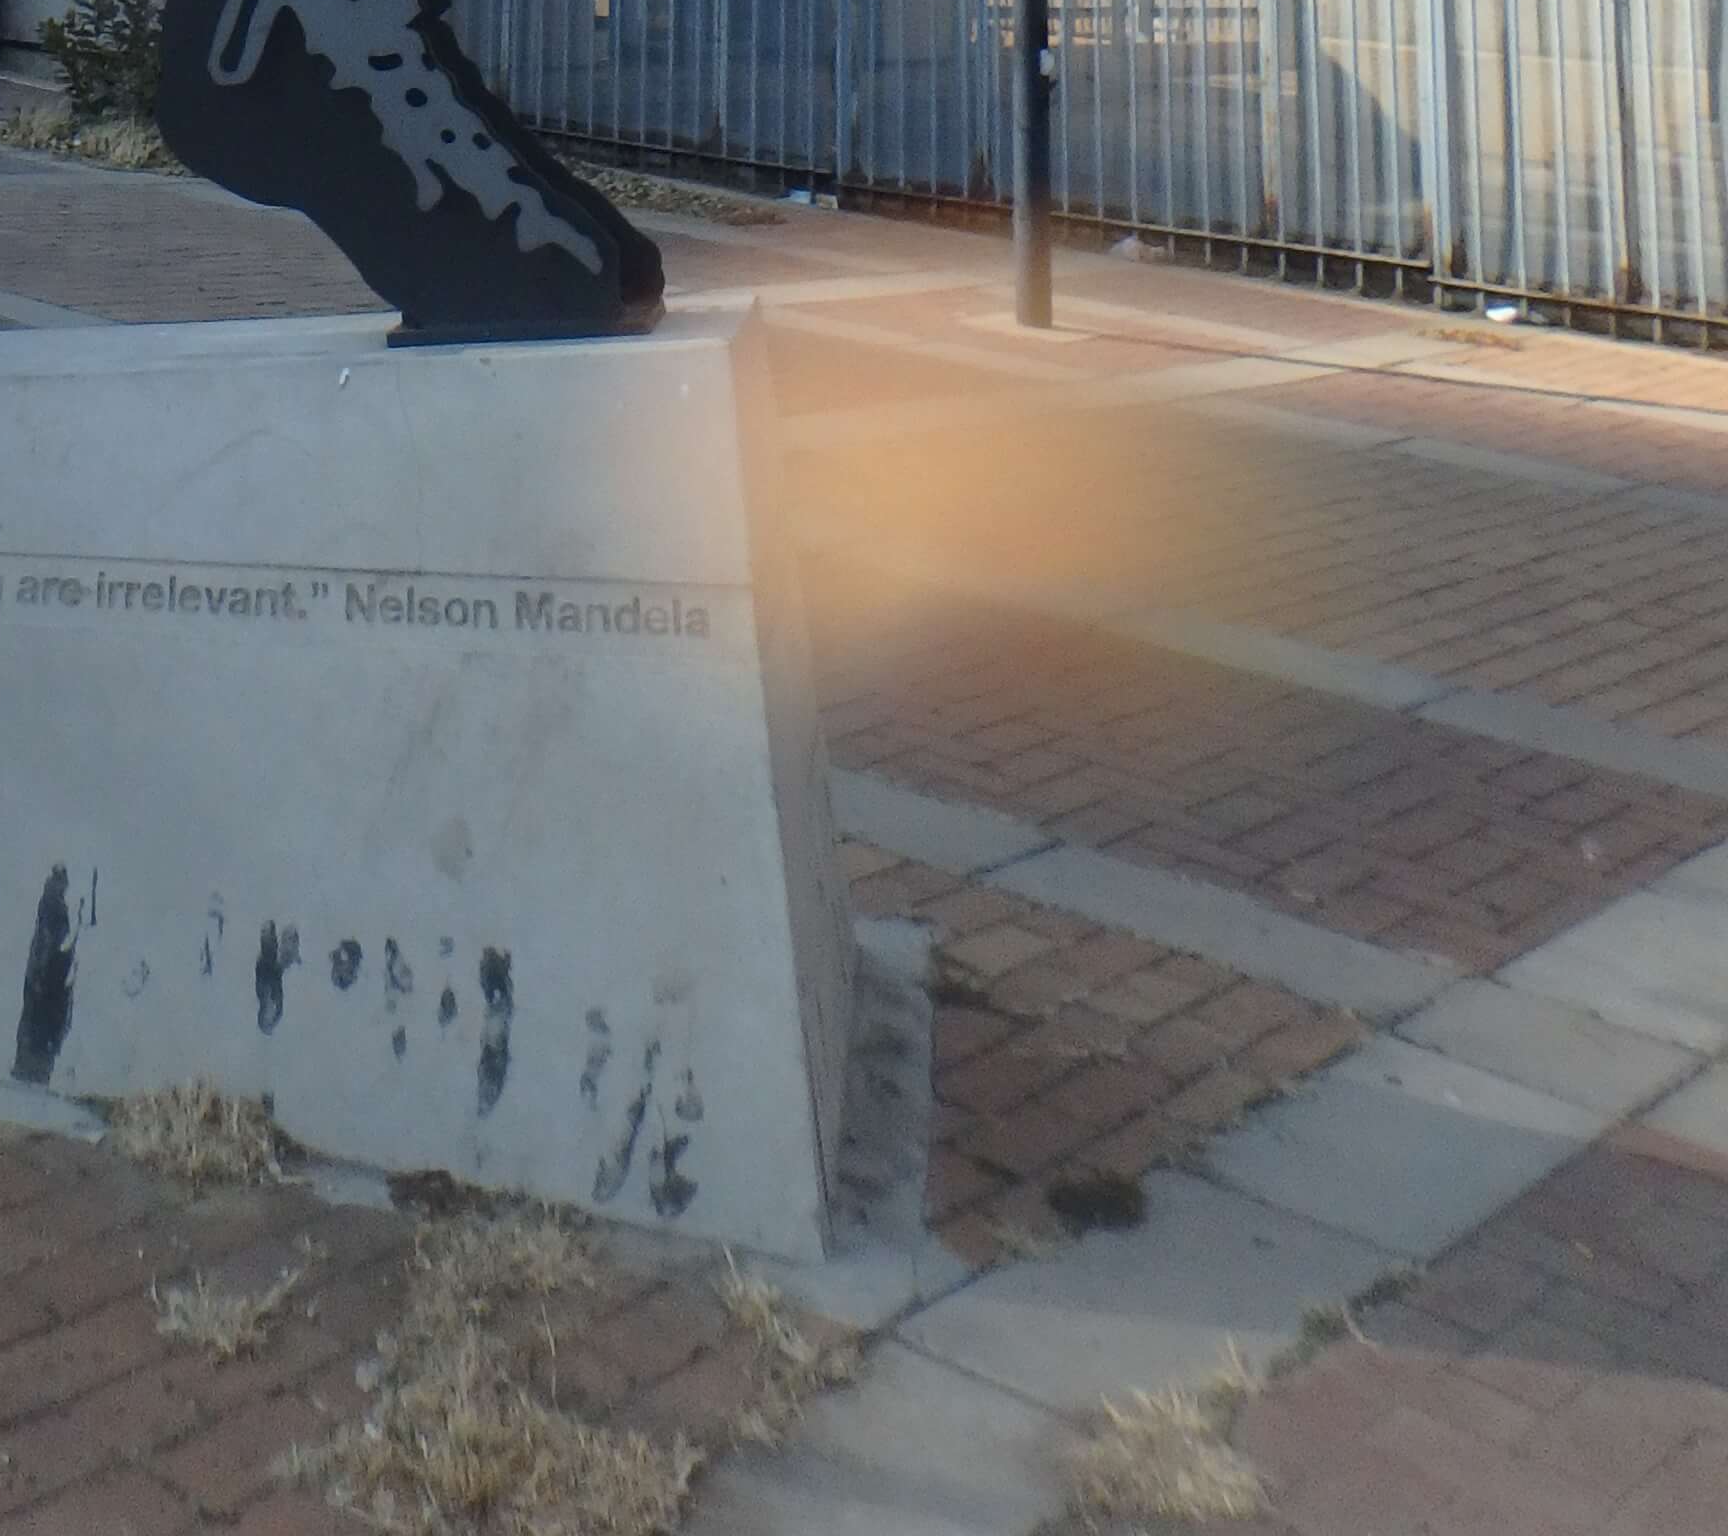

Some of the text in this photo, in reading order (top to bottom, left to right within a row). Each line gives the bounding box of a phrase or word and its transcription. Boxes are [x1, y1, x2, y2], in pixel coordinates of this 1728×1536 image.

[16, 574, 83, 607] are
[344, 582, 499, 630] Nelson
[513, 590, 711, 640] Mandela
